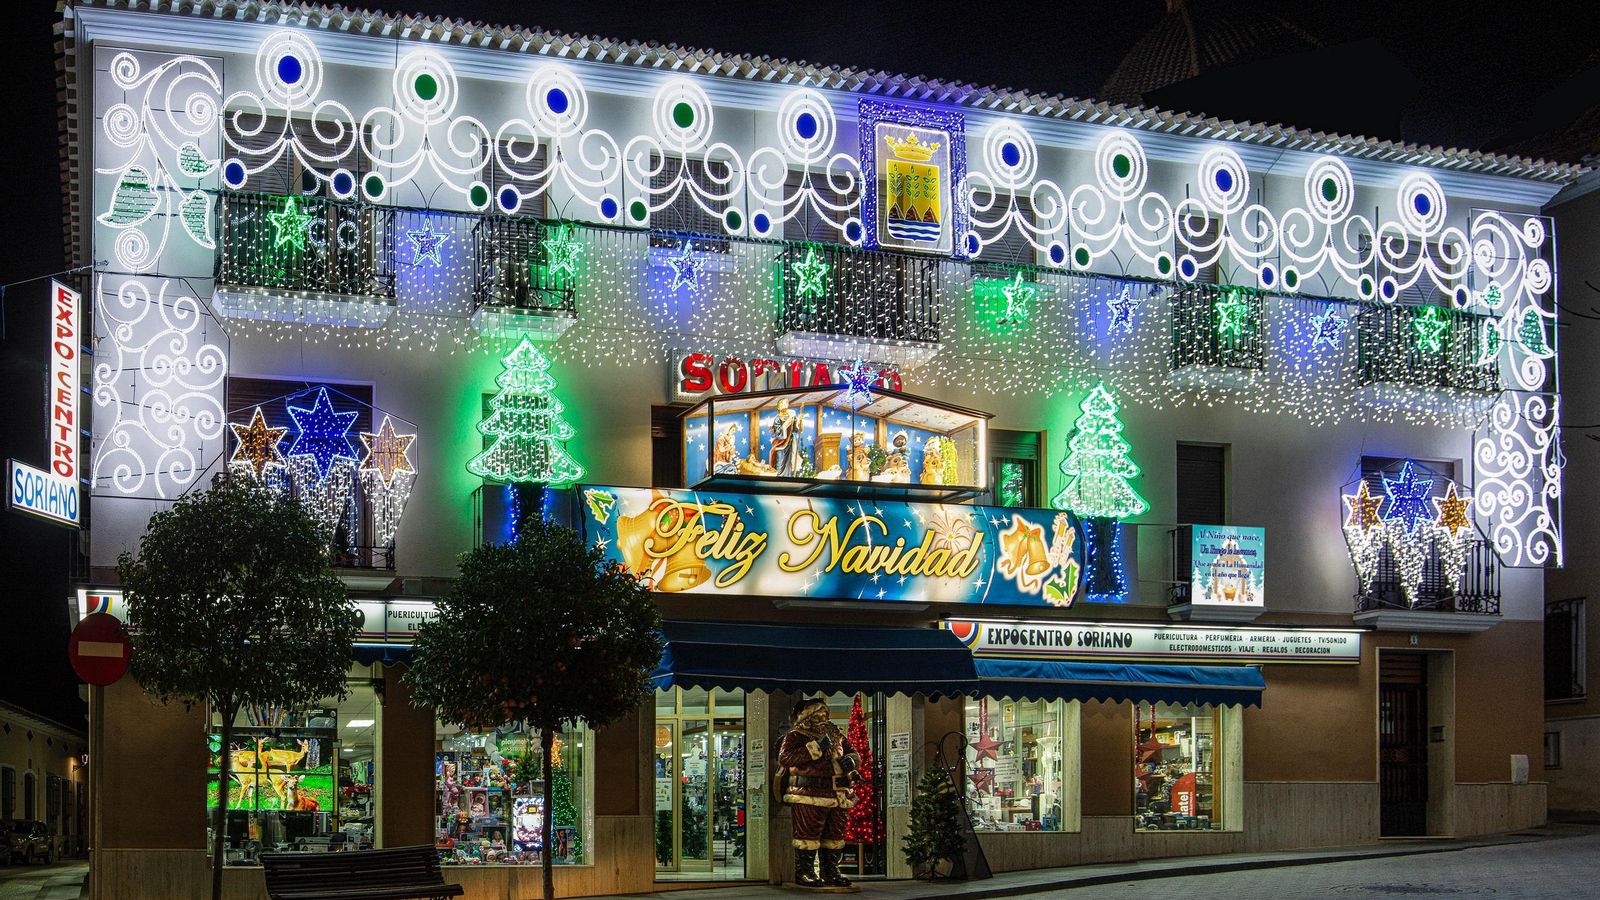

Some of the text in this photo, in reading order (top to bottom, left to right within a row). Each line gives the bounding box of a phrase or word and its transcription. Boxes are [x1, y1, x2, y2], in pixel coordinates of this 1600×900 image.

[53, 287, 75, 478] EXPO-CENTRO
[14, 468, 77, 520] SORIANO
[644, 498, 984, 587] Feliz Navidad
[1207, 530, 1226, 540] Niño
[987, 628, 1133, 648] EXPOCENTRO SORIANO
[1154, 633, 1198, 641] PUERICULTURA
[1205, 634, 1243, 642] PERFUMERIA
[1250, 635, 1276, 643] ARMERIA
[1283, 636, 1312, 644] JUGUETES
[1169, 644, 1232, 652] ELECTRODOMESTICOS
[1238, 645, 1255, 653] VIAJE
[1262, 646, 1288, 654] REGALOS
